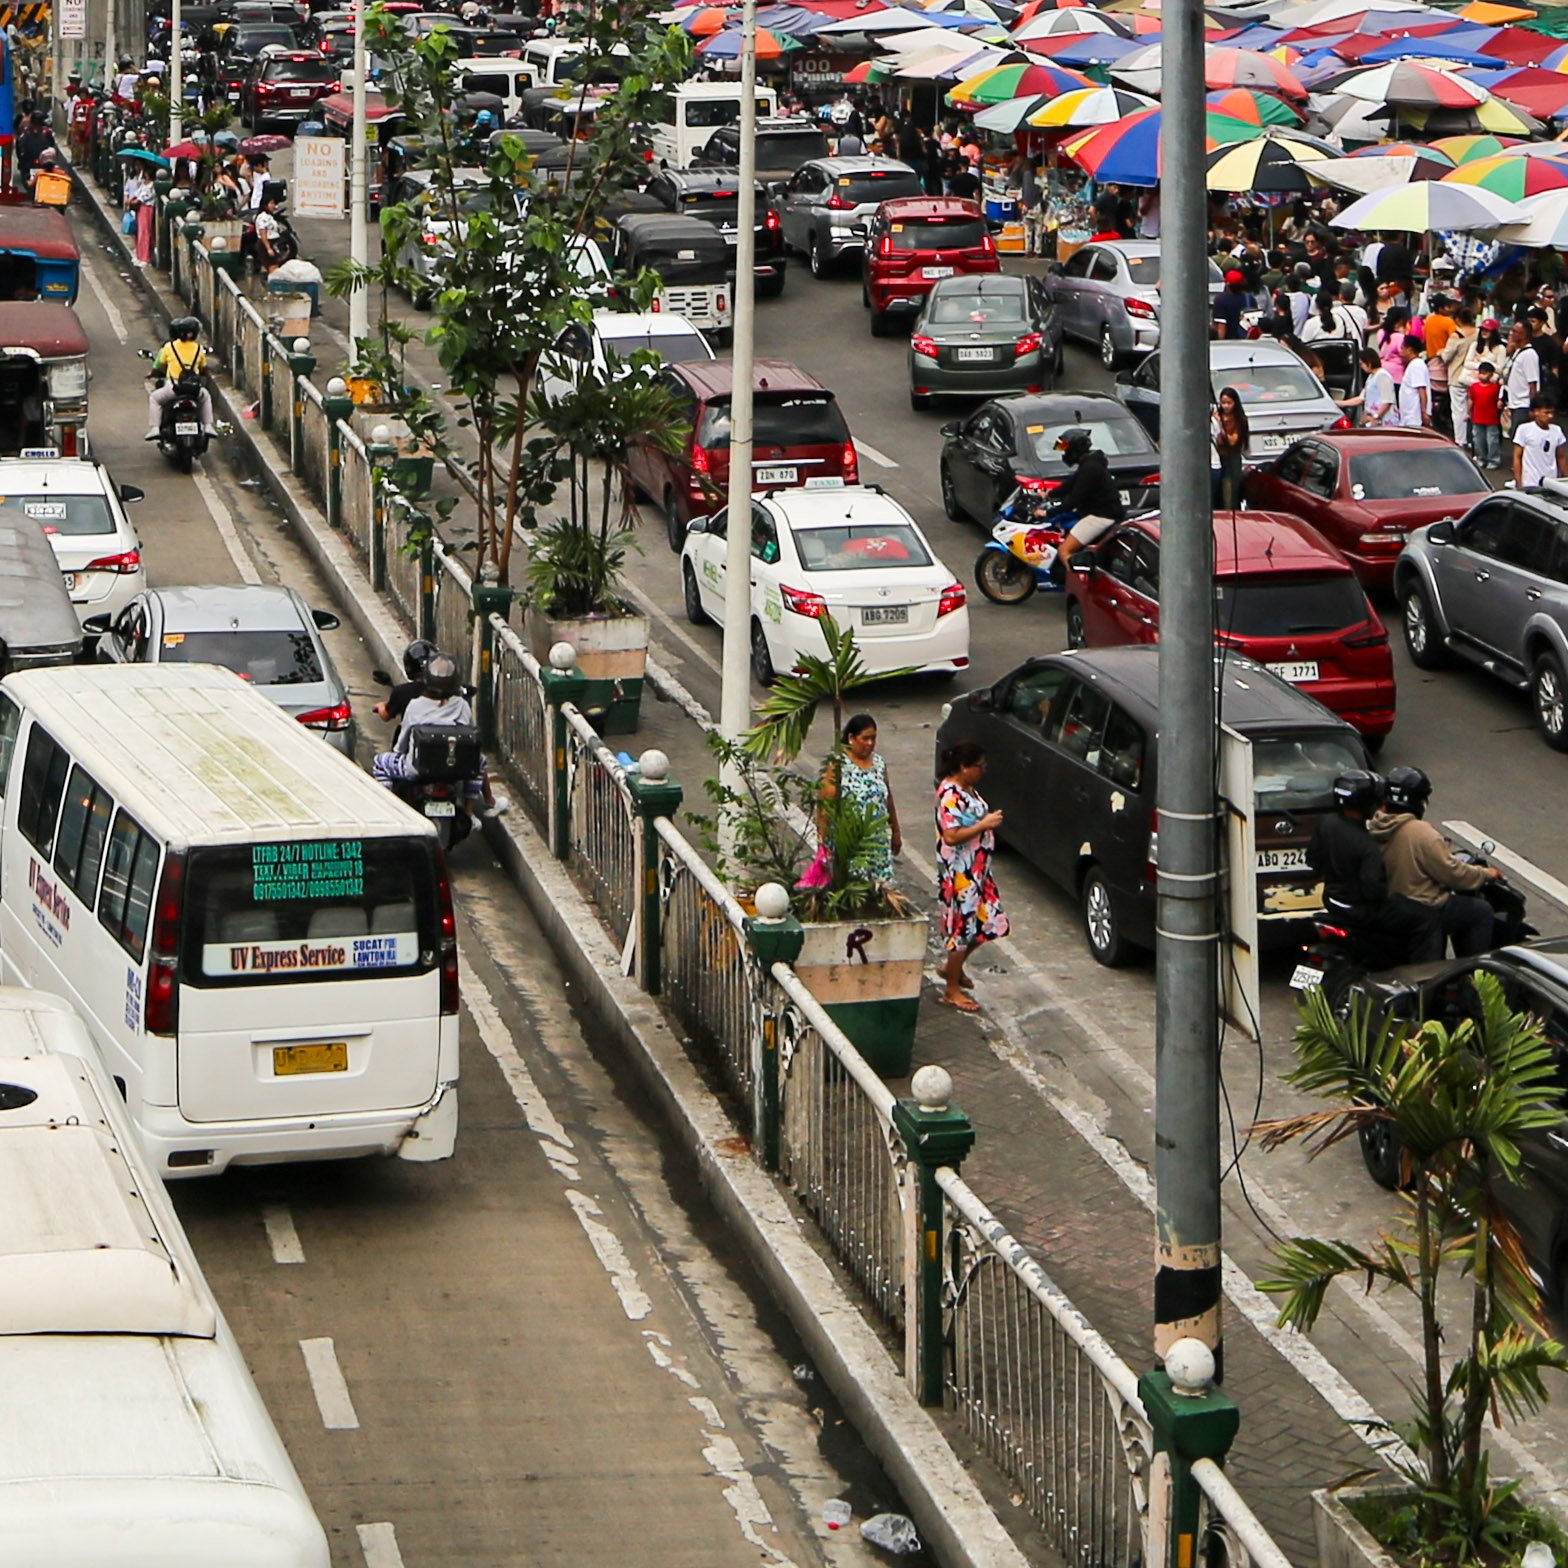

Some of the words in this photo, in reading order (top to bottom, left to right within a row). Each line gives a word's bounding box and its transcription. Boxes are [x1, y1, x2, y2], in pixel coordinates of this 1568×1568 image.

[306, 143, 332, 156] NO
[1292, 665, 1317, 677] 1771
[252, 845, 279, 864] LTFRB
[280, 844, 300, 862] 24/7
[302, 844, 340, 860] HOTLINE:
[341, 842, 362, 859] 1342
[353, 938, 383, 951] SUCAT
[846, 929, 874, 965] R
[230, 946, 249, 970] UV
[250, 945, 298, 973] Express
[300, 944, 345, 966] Service
[353, 950, 385, 964] LAWTON
